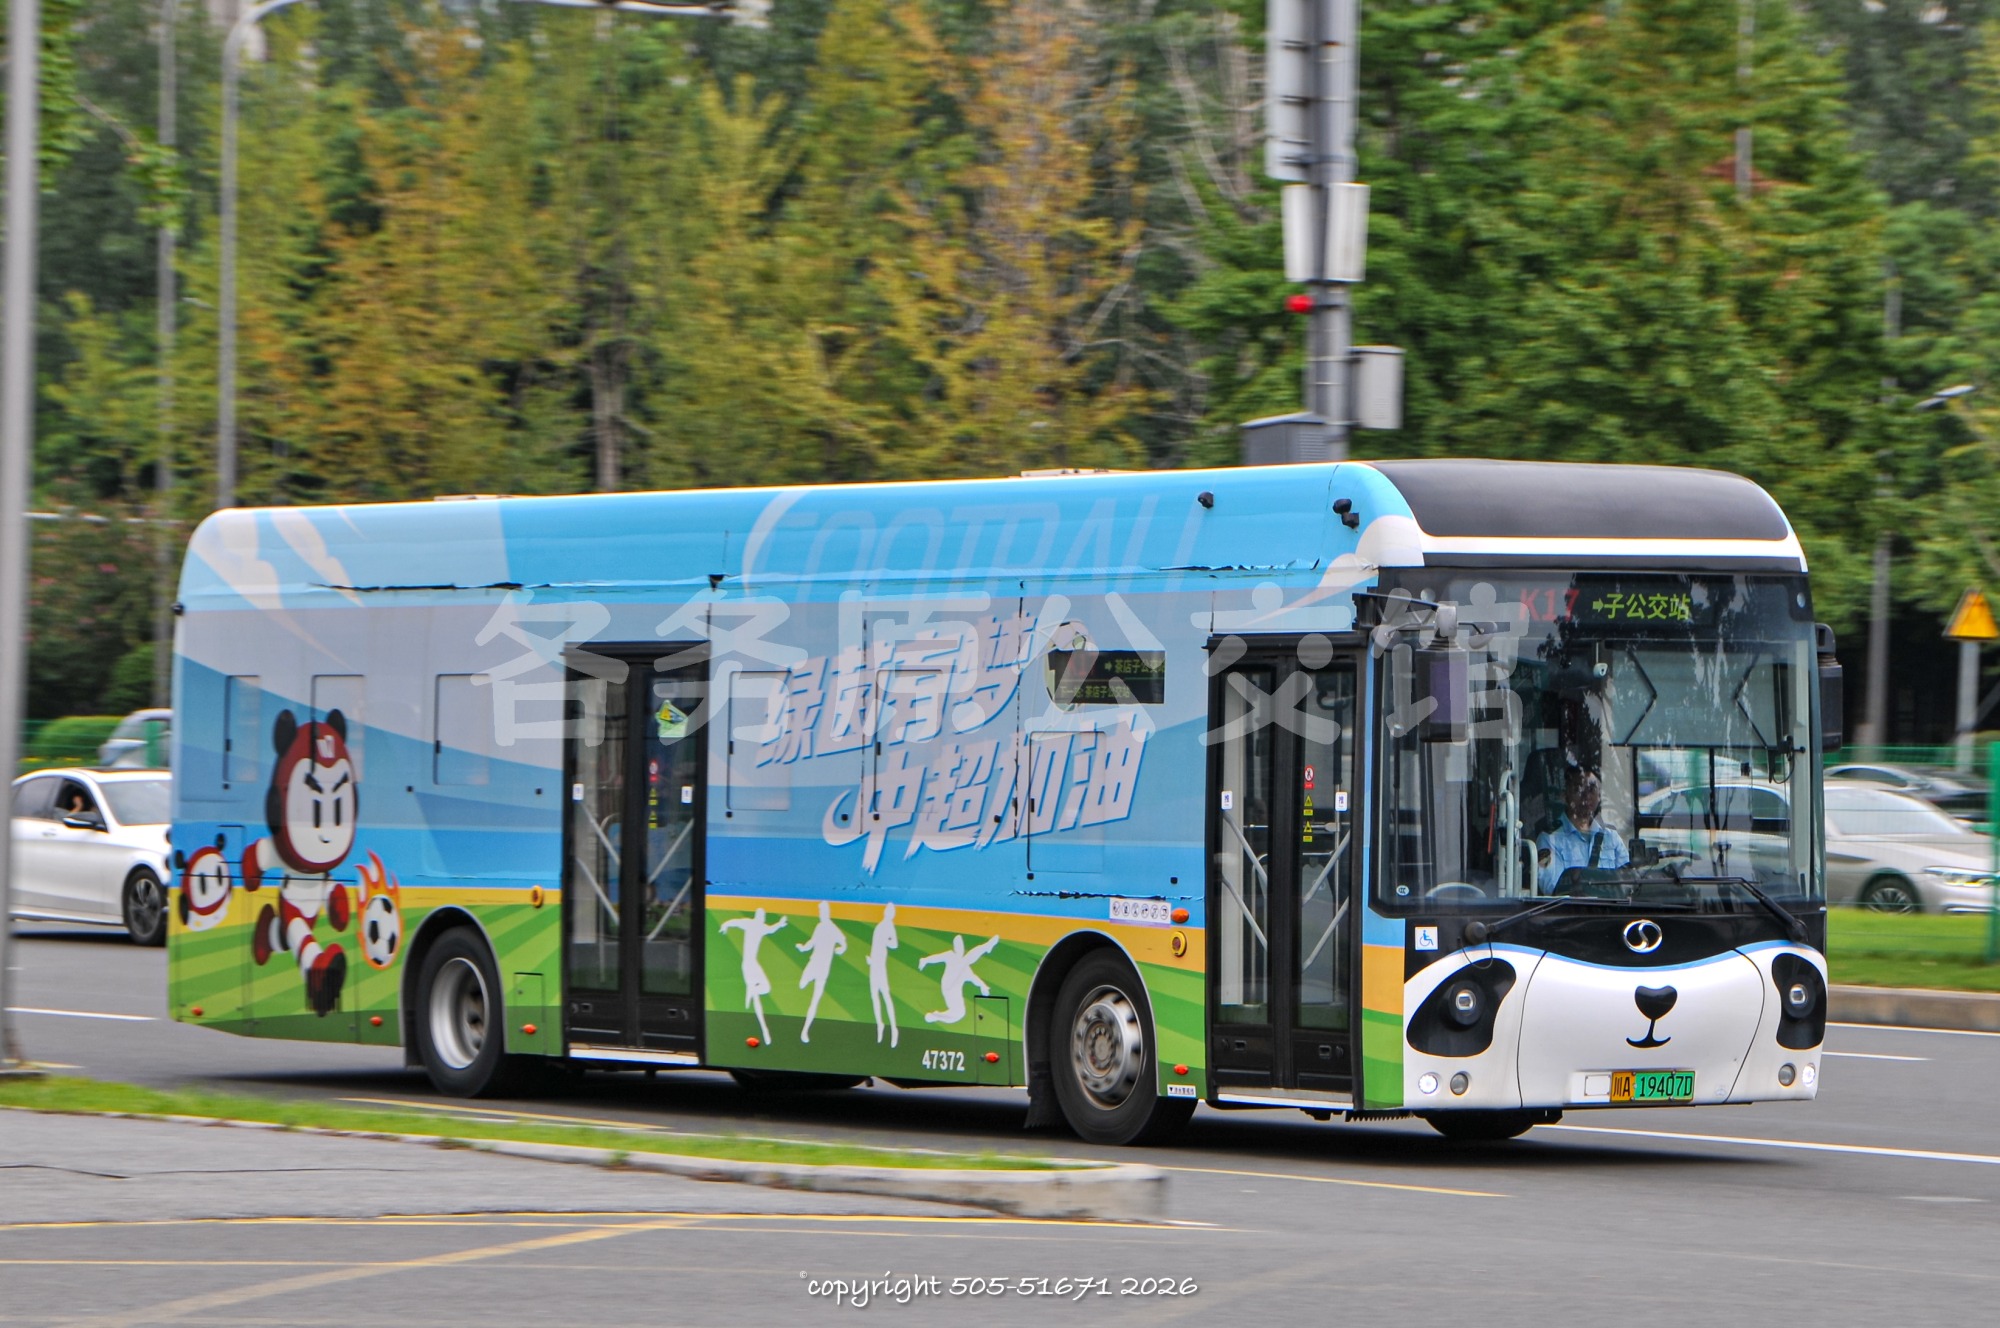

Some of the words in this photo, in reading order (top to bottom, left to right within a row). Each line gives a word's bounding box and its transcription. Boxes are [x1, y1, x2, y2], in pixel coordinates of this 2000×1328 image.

[1519, 588, 1580, 622] K17
[1604, 593, 1691, 620] 子公交站
[757, 611, 1038, 768] 绿茵有梦
[822, 711, 1149, 876] 中超加油
[922, 1049, 965, 1071] 47372
[1613, 1076, 1631, 1097] 川A
[1640, 1075, 1693, 1098] 19407D
